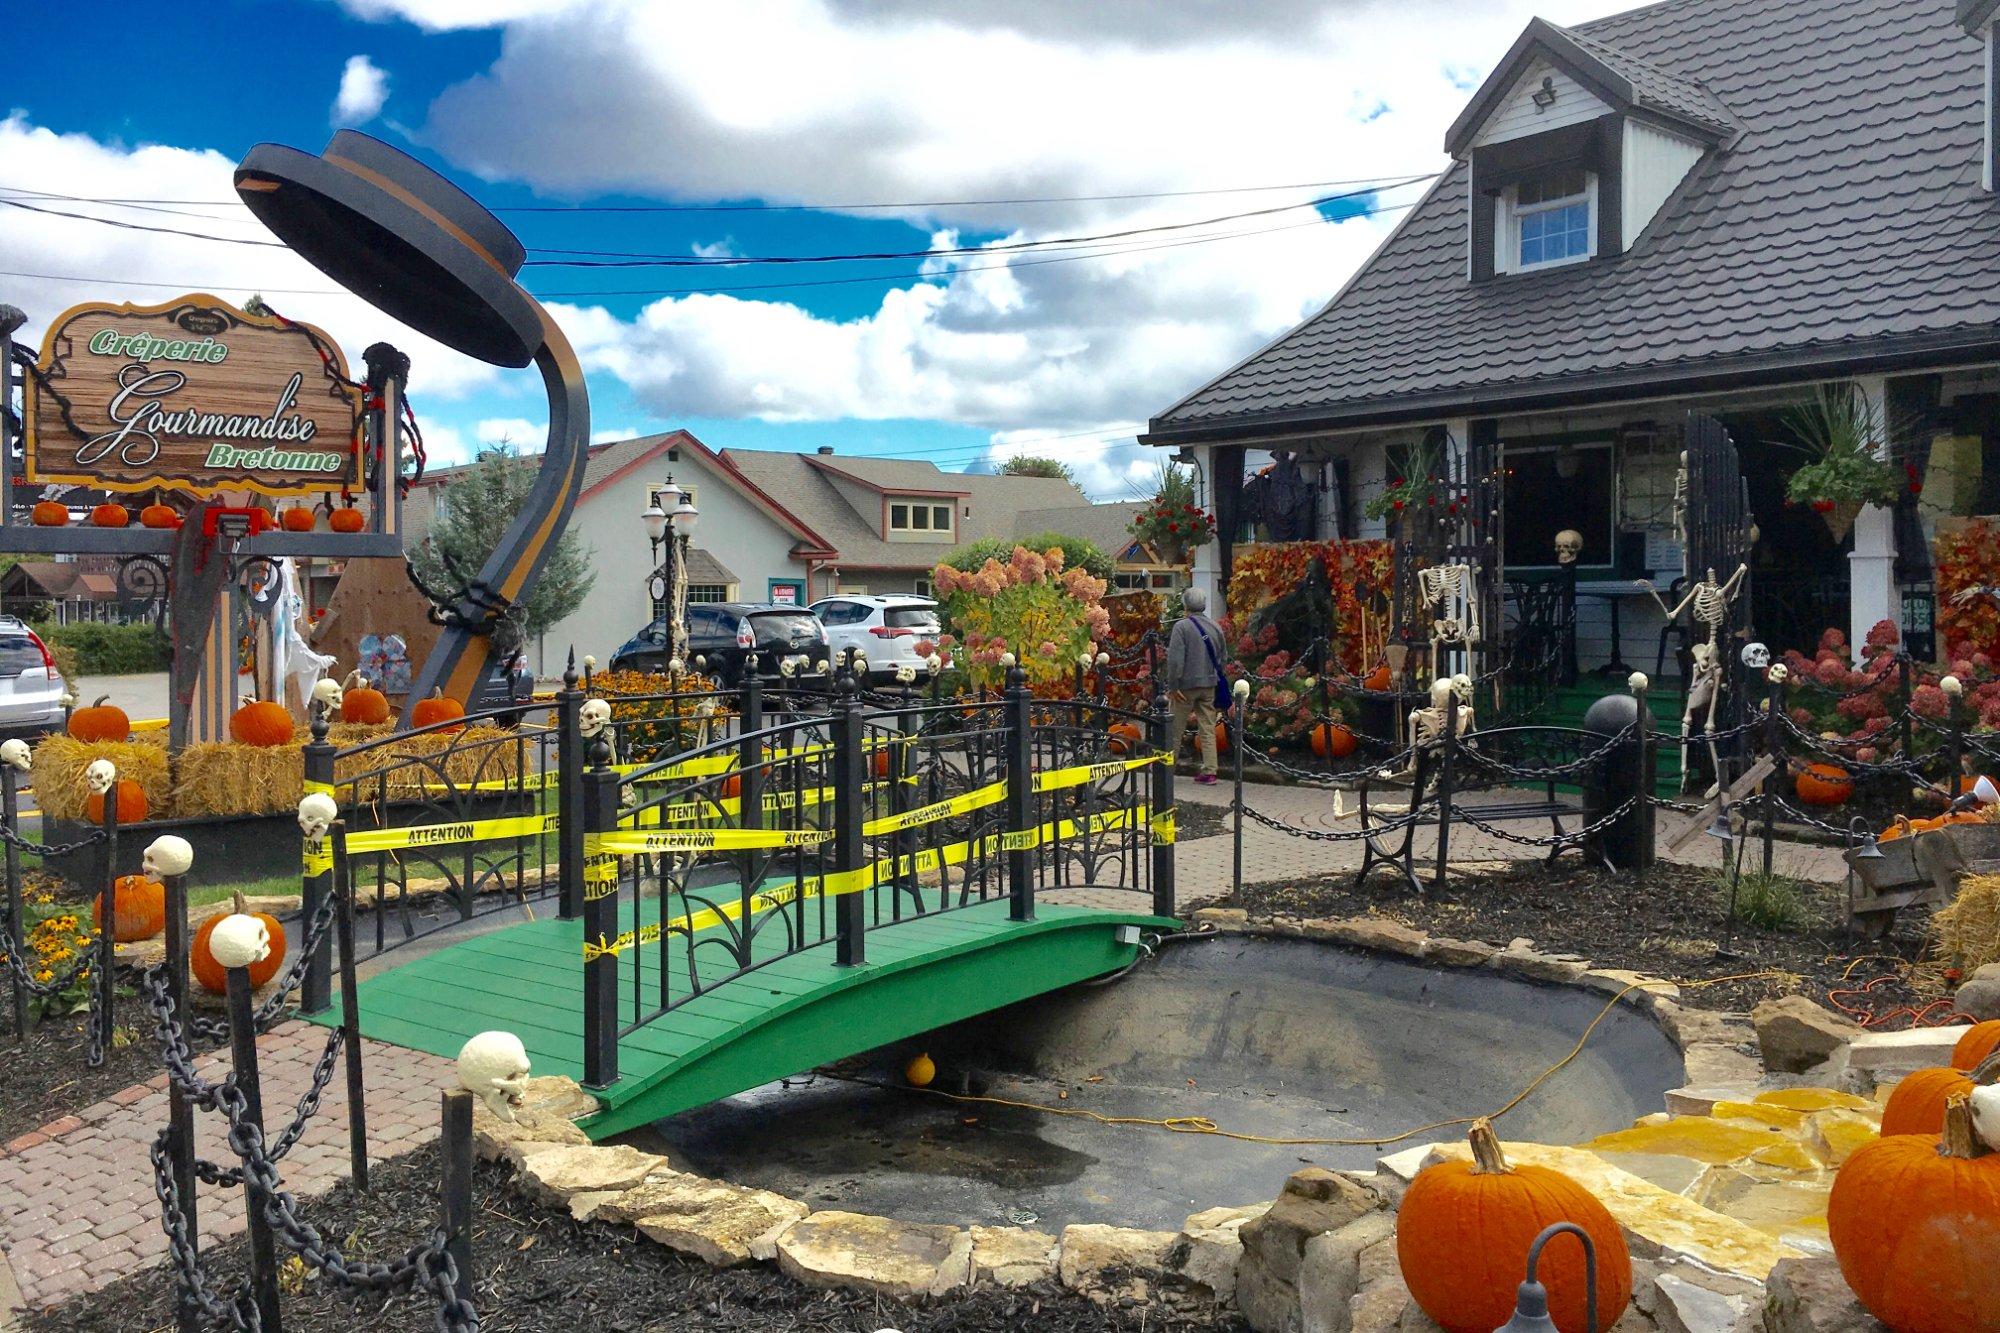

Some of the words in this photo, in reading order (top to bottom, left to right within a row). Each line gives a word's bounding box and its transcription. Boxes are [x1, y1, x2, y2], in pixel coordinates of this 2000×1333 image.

[90, 329, 228, 363] Crêperie
[75, 364, 316, 466] Gourmandise
[204, 443, 342, 472] Bretonne
[409, 824, 474, 844] ATTENTION
[646, 833, 715, 848] ATTENTION
